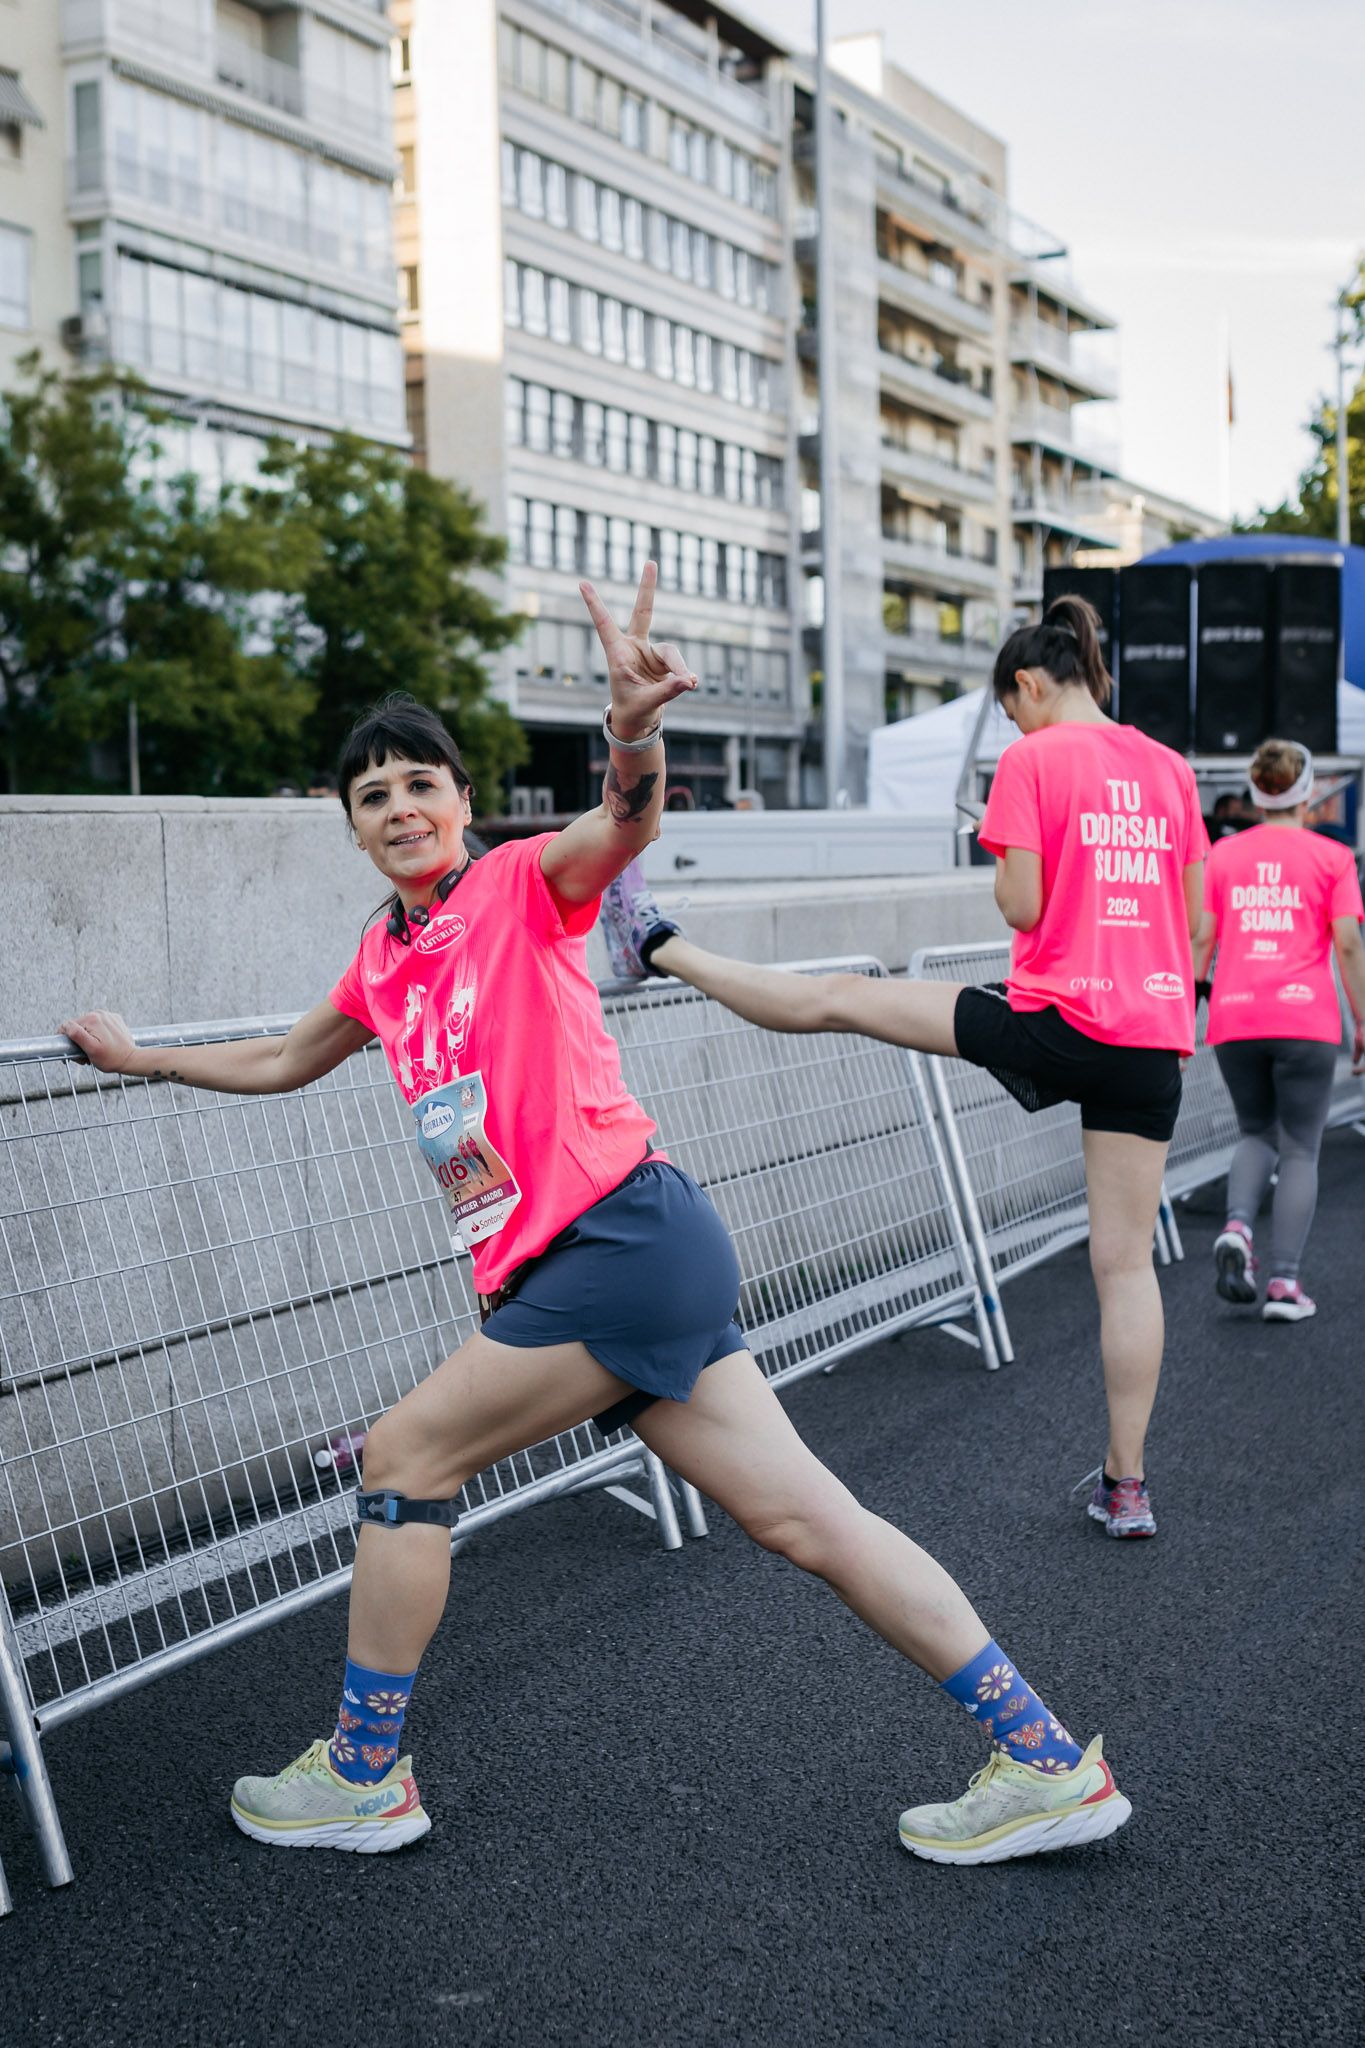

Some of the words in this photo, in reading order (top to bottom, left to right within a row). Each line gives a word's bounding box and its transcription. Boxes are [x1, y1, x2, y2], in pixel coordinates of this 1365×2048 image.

[1106, 778, 1141, 812] TU
[1080, 812, 1172, 850] DORSAL
[1095, 849, 1160, 885] SUMA
[1256, 862, 1281, 884] TU
[1106, 897, 1139, 916] 2024
[1231, 885, 1303, 910] DORSAL
[1240, 910, 1294, 932] SUMA
[480, 1188, 504, 1205] MADRID
[353, 1790, 398, 1817] HOKA
